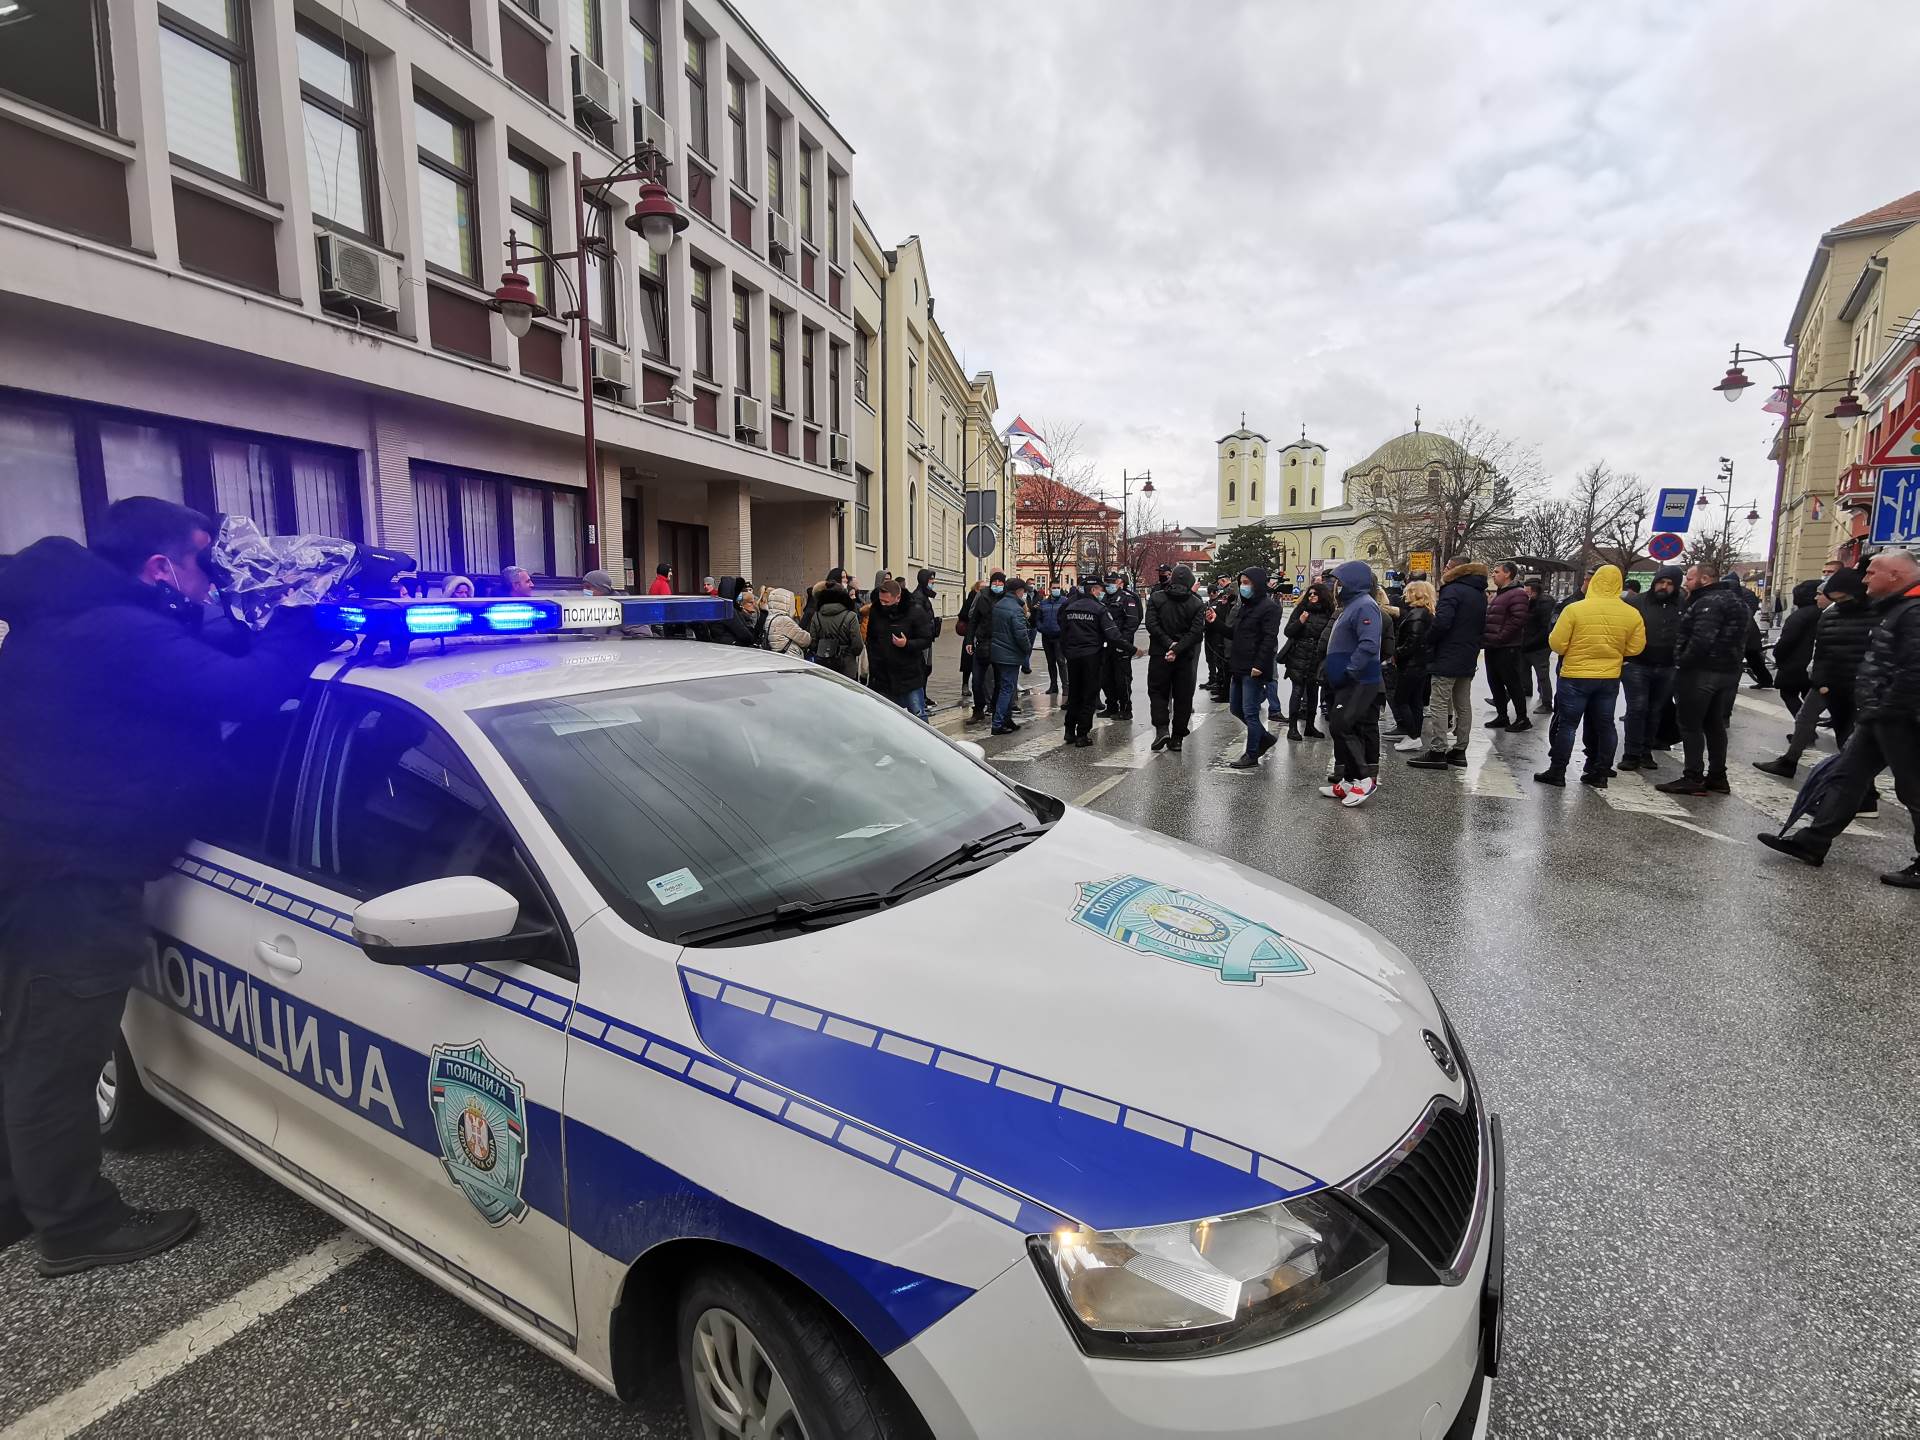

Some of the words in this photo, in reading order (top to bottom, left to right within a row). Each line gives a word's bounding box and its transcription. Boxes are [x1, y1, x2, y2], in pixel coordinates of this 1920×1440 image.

[563, 607, 621, 624] ПОЛИЦИЈА
[1089, 879, 1143, 918] ПОЛИЦИЈА
[446, 1062, 507, 1102] ПОЛИЦИЈА
